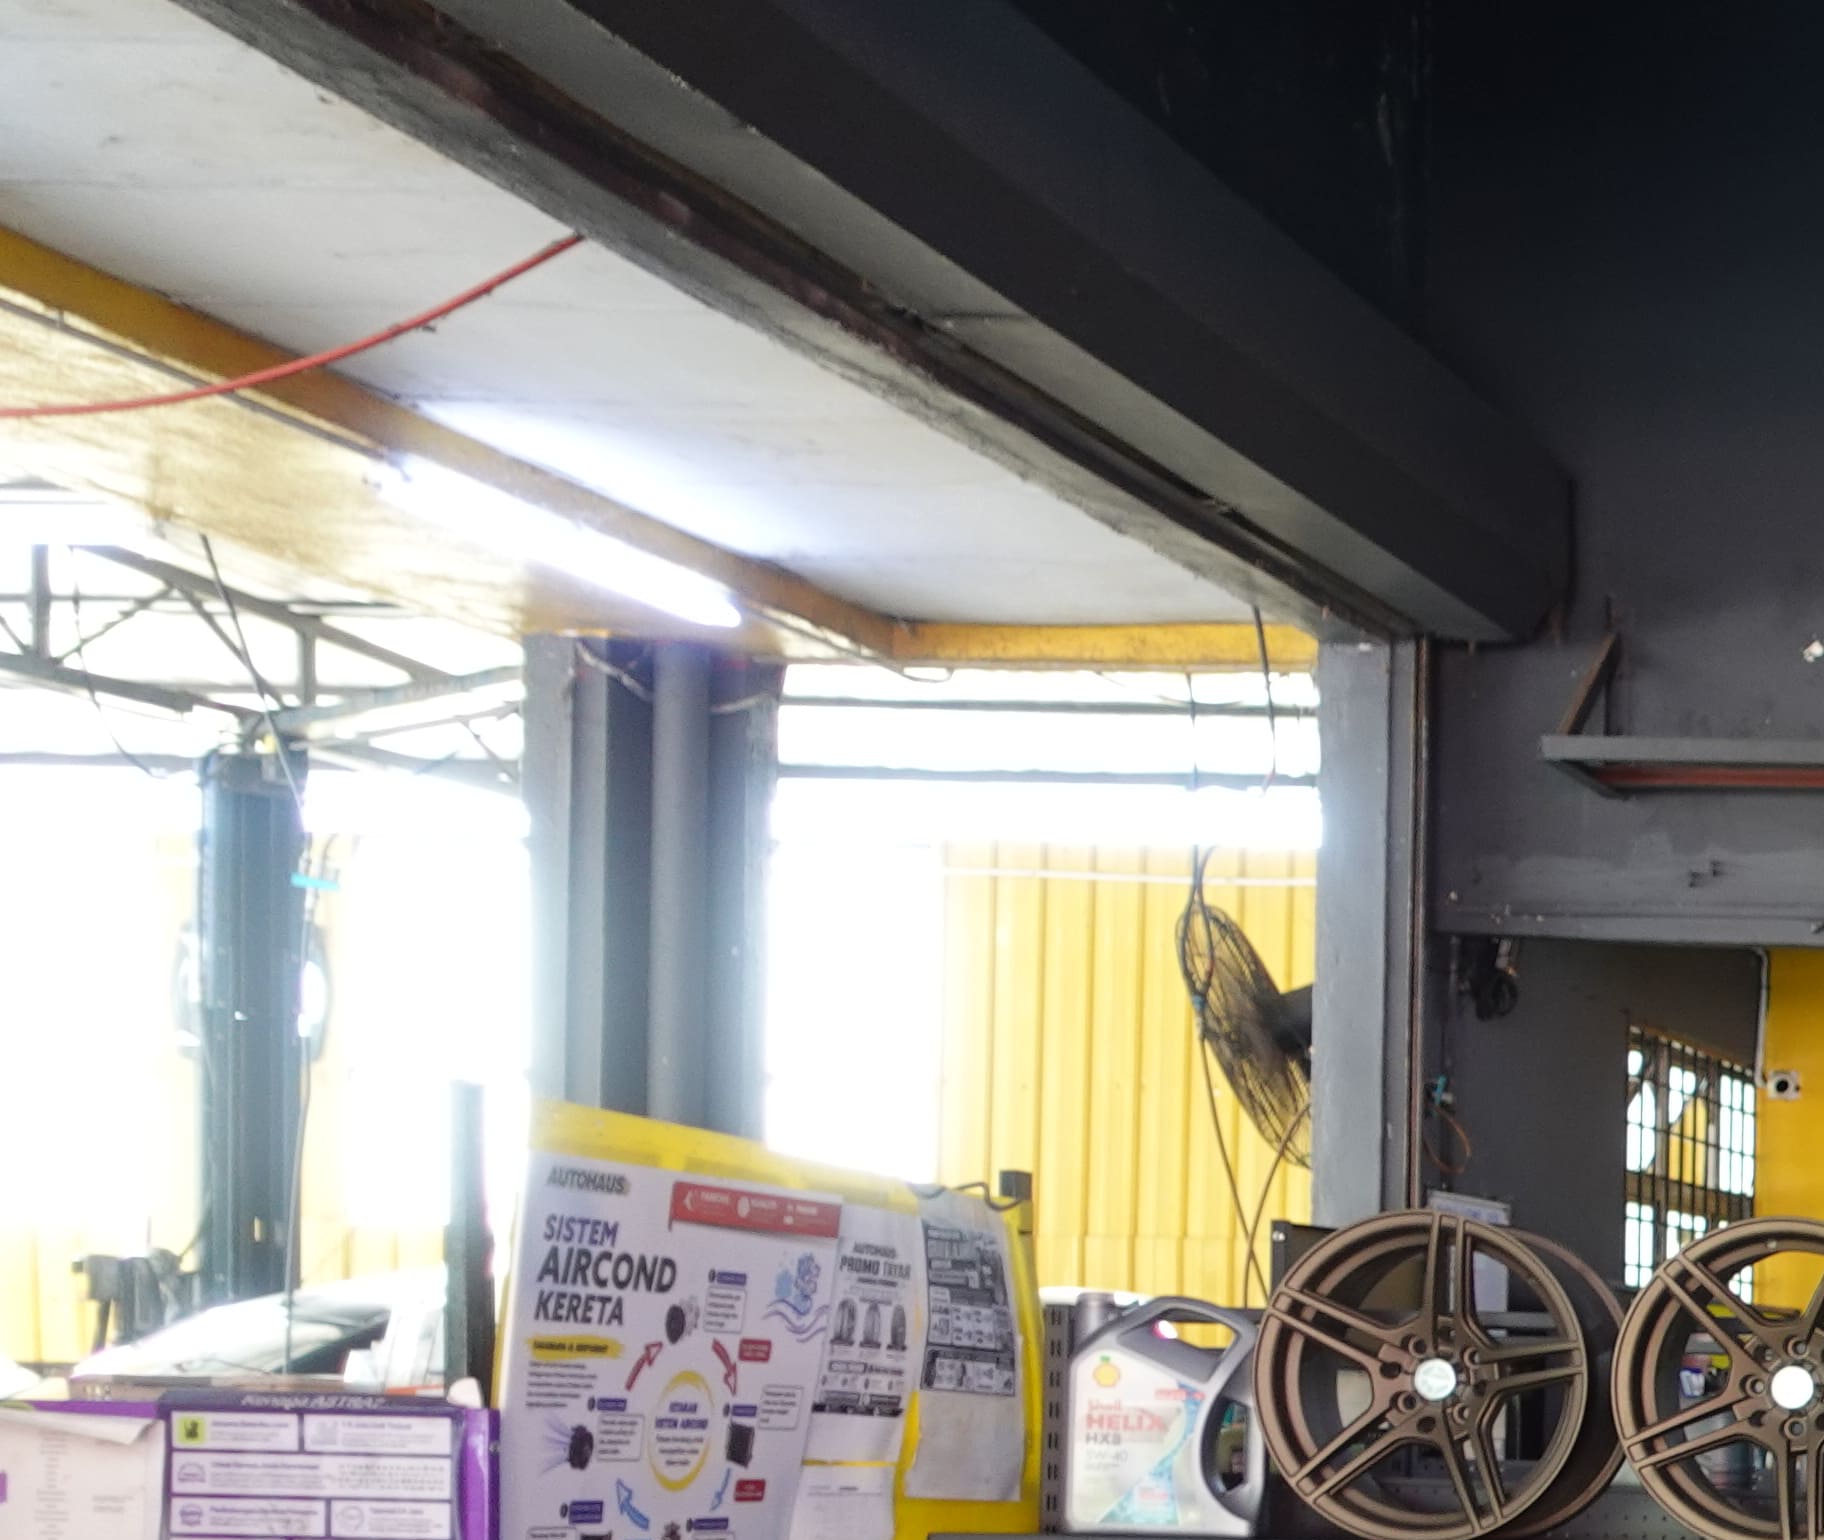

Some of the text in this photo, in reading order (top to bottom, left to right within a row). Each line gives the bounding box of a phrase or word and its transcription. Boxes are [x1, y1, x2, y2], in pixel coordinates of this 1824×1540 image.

[547, 1167, 627, 1193] AUTOHAUS
[544, 1214, 619, 1247] SISTEM
[537, 1246, 678, 1294] AIRCOND
[533, 1290, 625, 1326] KERETA
[1085, 1413, 1169, 1432] HELIX
